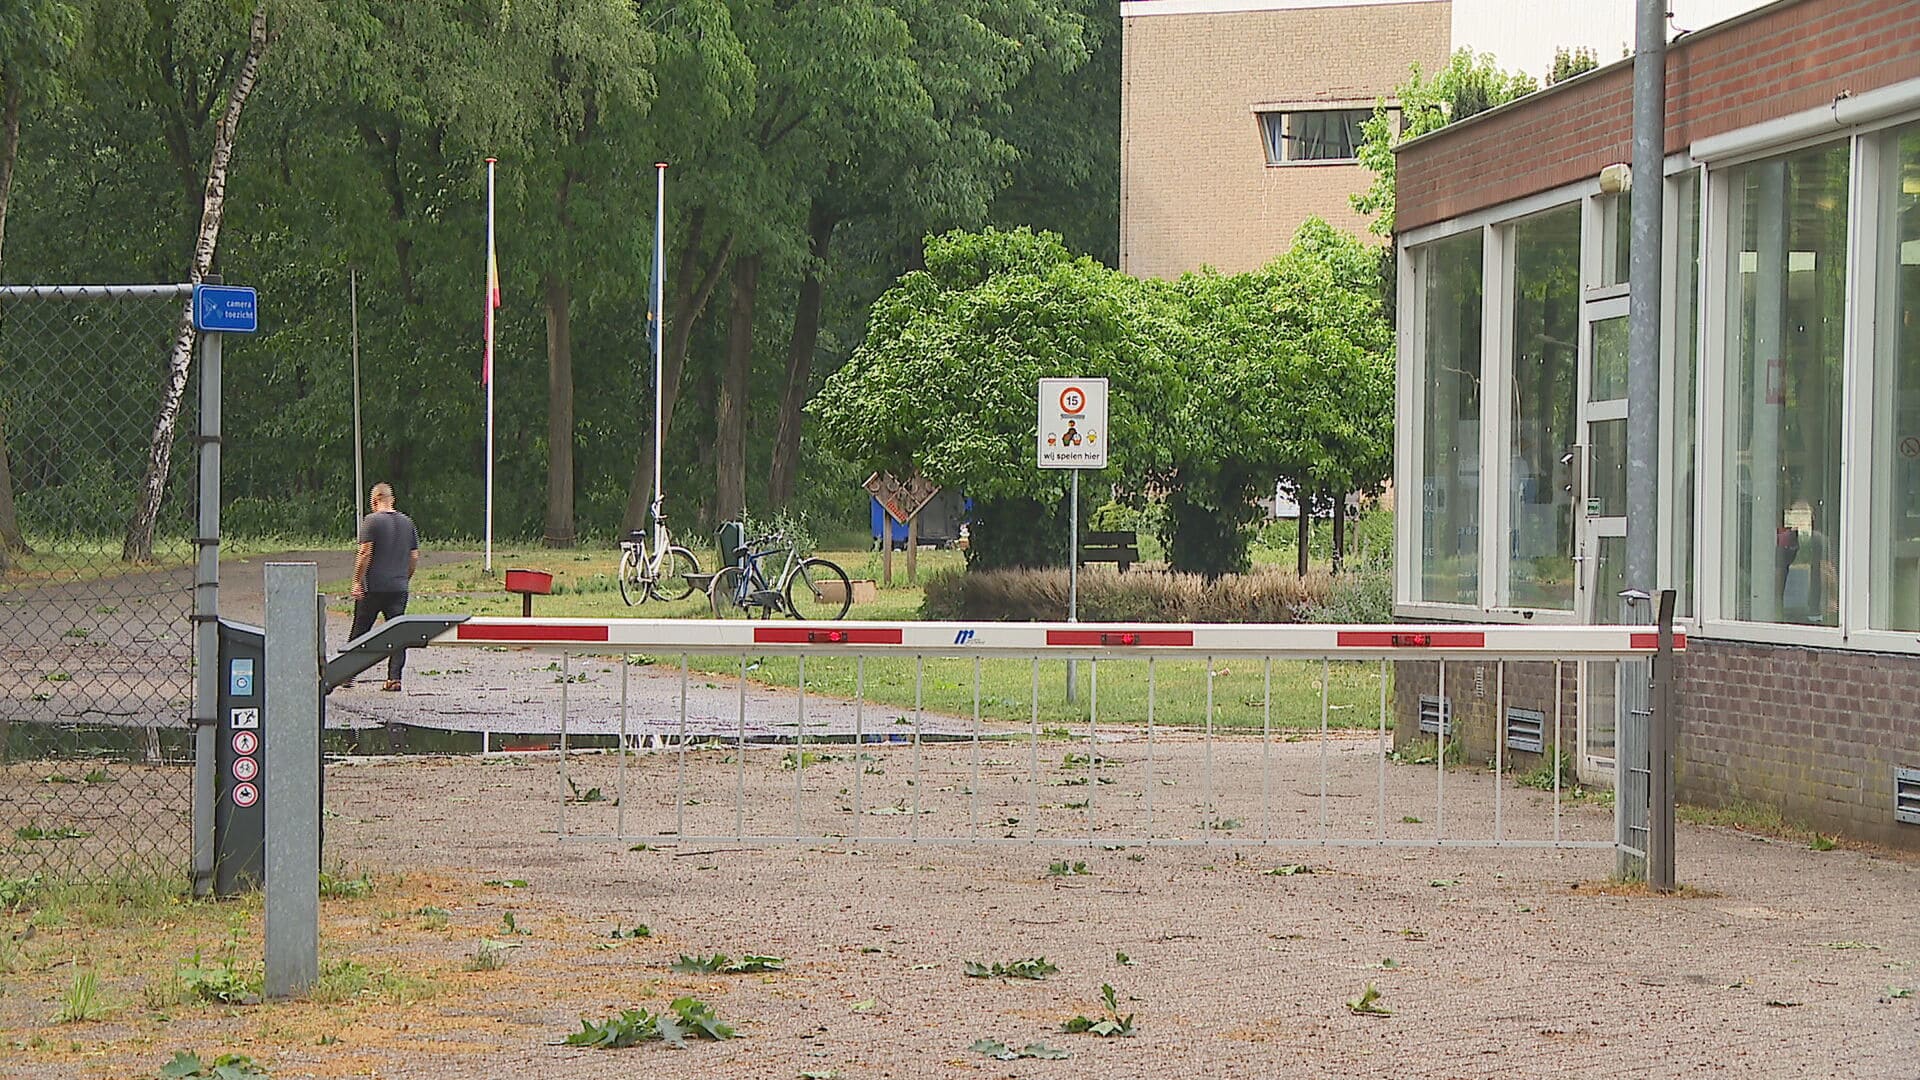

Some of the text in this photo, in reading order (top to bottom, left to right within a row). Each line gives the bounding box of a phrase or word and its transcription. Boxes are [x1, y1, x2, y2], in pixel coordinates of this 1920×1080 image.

[226, 300, 252, 309] camera
[224, 310, 254, 319] toezicht
[1066, 395, 1079, 406] 15
[1043, 451, 1100, 461] wij spelen hier
